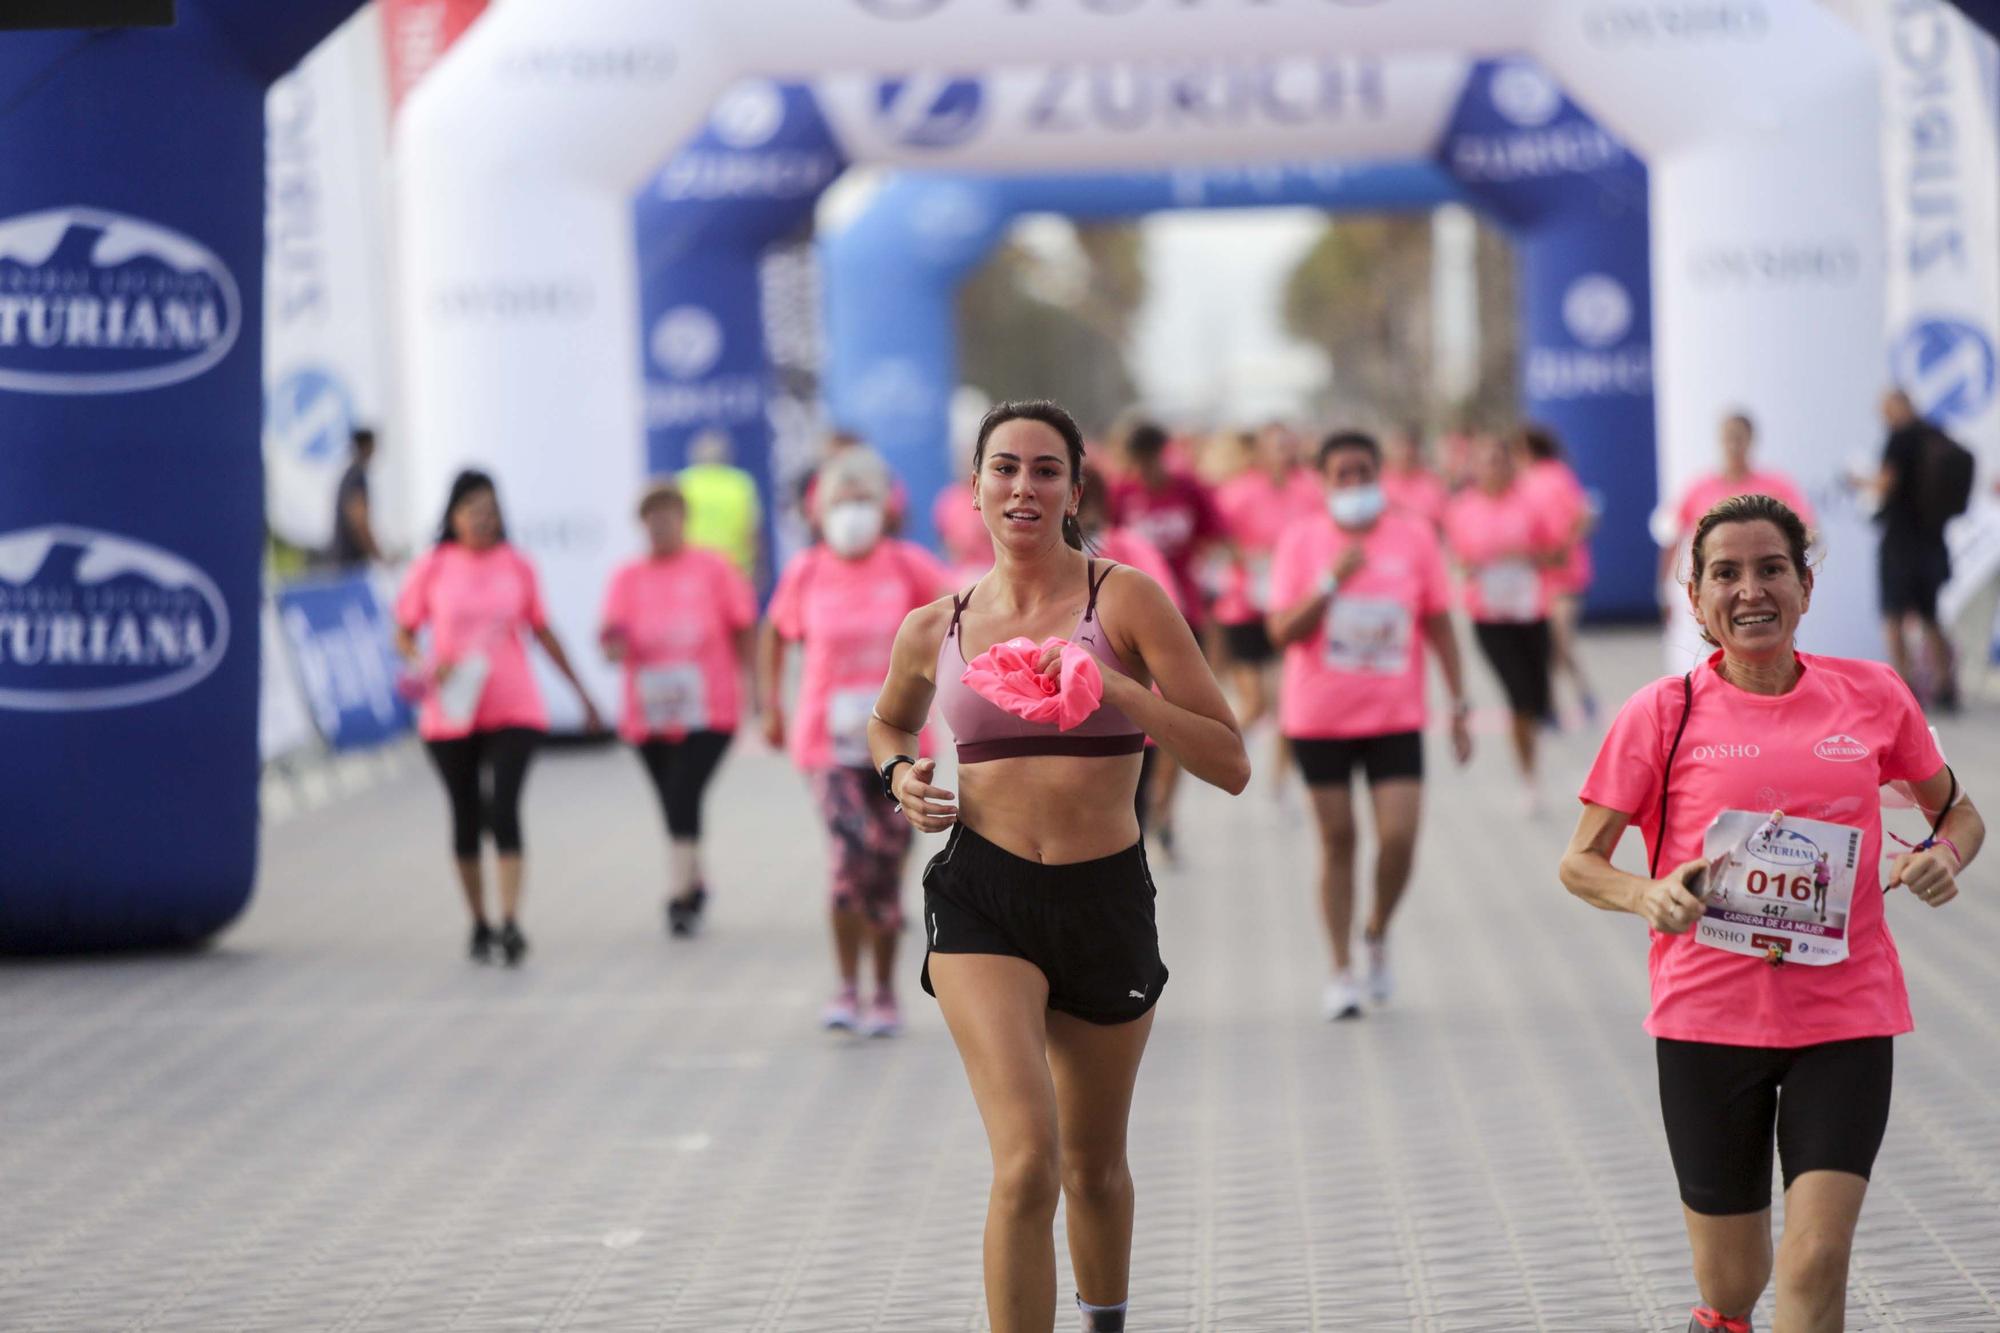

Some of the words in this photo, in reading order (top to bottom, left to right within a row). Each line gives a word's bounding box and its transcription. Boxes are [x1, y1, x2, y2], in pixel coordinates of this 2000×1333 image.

[1018, 58, 1386, 134] ZURICH
[0, 615, 206, 666] URIANA
[1692, 744, 1760, 760] OYSHO
[1747, 870, 1811, 902] 016
[1762, 904, 1788, 917] 447
[1702, 925, 1745, 944] OYSHO
[1724, 911, 1764, 926] CARRERA
[1765, 918, 1777, 928] DE
[1779, 921, 1794, 930] LA
[1795, 922, 1826, 935] MUJER
